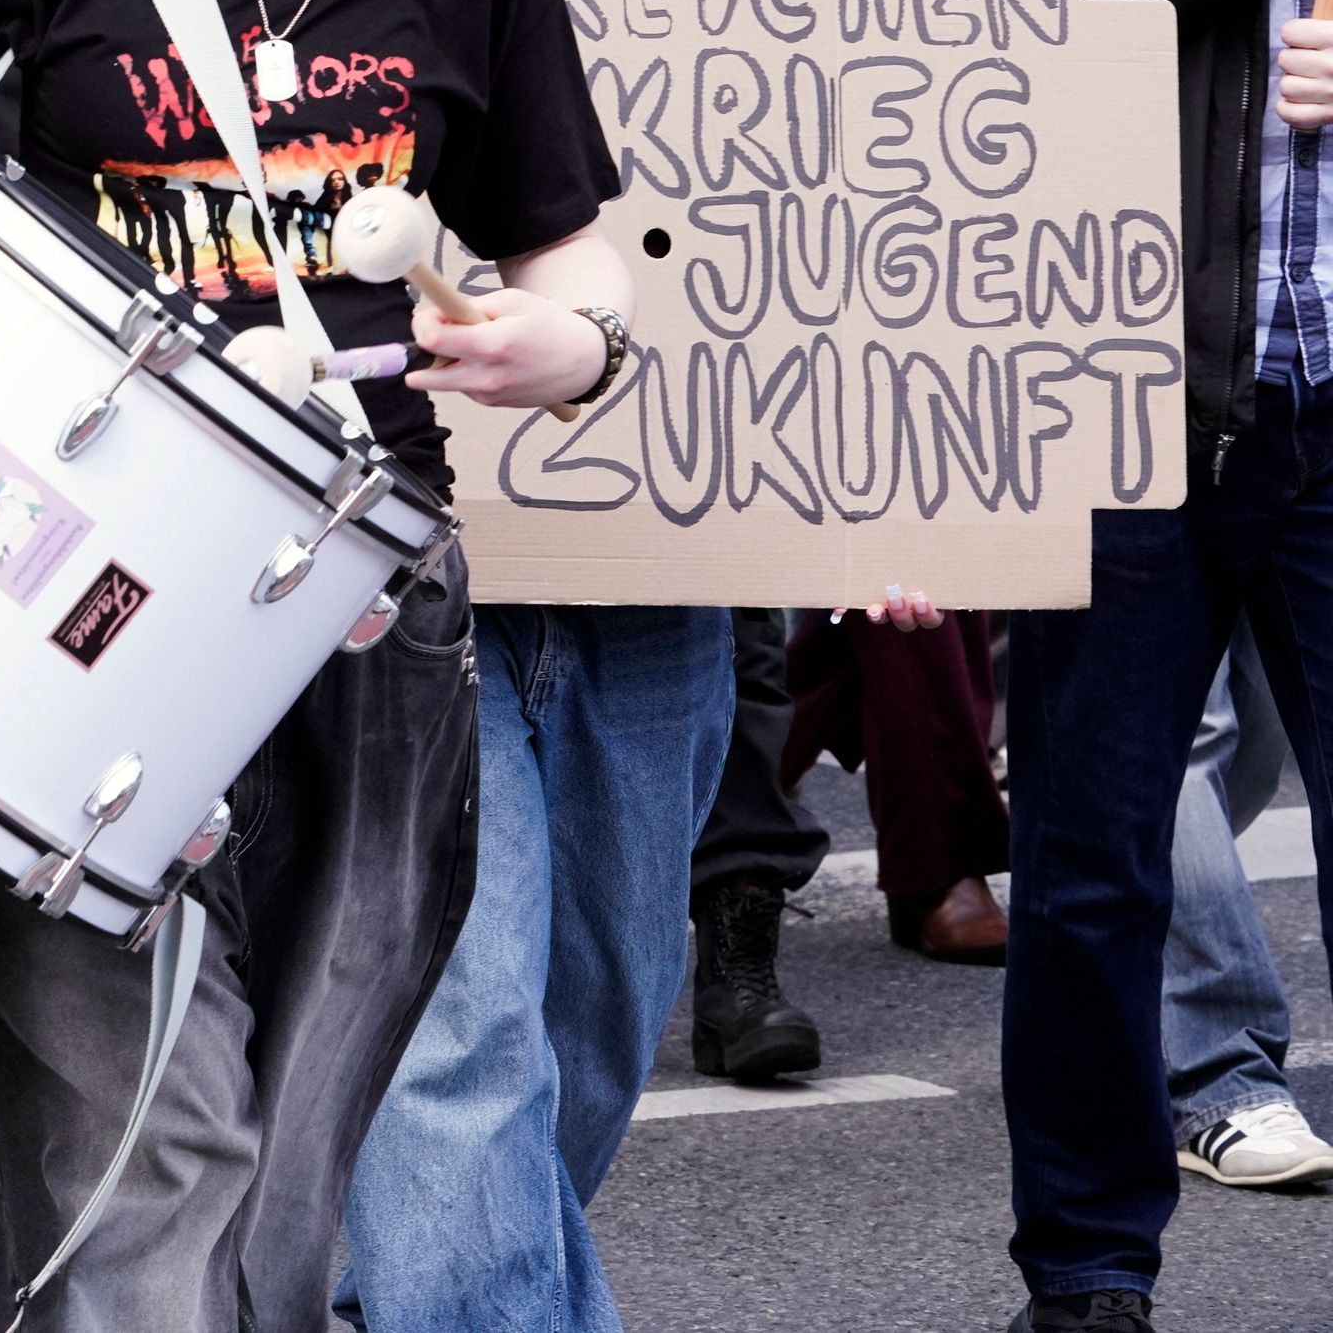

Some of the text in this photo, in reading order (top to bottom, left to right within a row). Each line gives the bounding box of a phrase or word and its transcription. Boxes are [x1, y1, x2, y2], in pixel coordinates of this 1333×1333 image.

[585, 46, 1038, 201] KRIEG
[684, 191, 1181, 340] JUGEND
[498, 333, 1183, 528] ZUKUNFT
[69, 571, 141, 650] Fame
